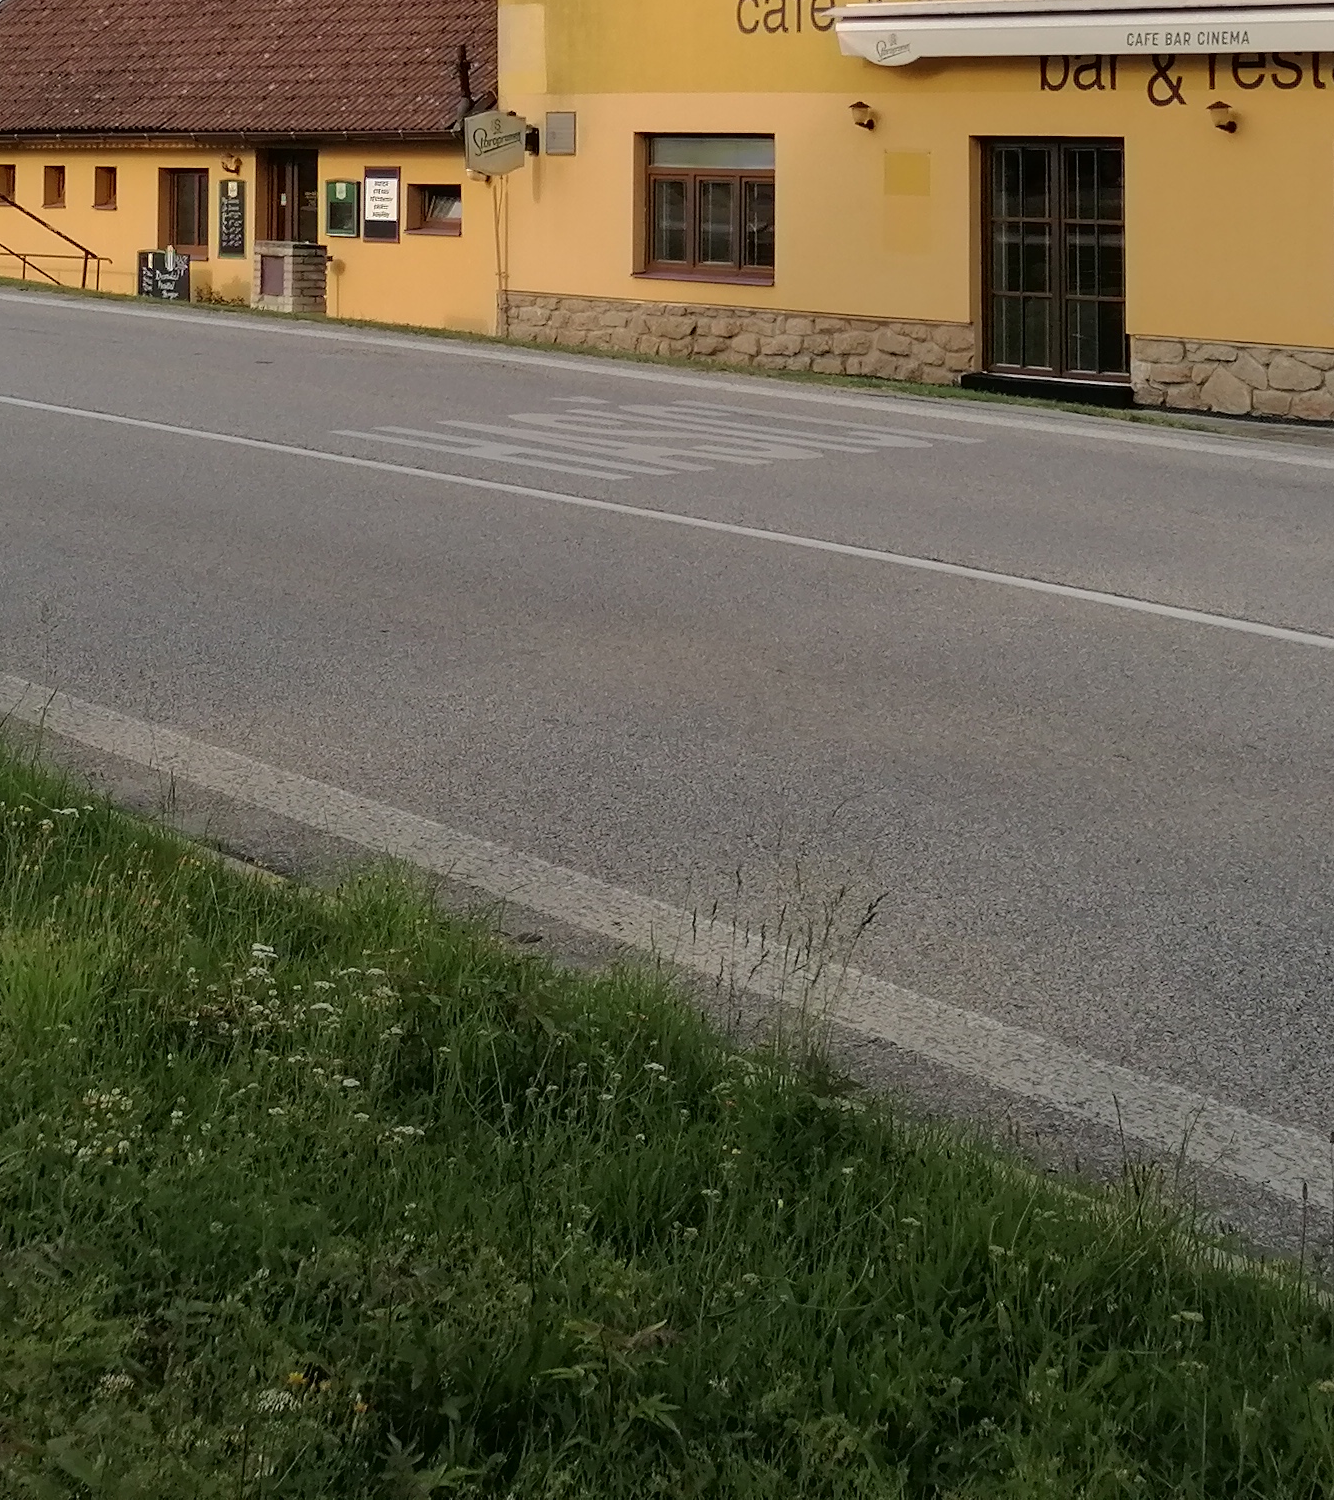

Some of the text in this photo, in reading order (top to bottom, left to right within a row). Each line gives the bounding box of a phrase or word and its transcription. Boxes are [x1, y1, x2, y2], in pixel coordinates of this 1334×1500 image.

[1127, 30, 1250, 46] CAFE BAR CINEMA
[329, 395, 986, 480] HASIČI
